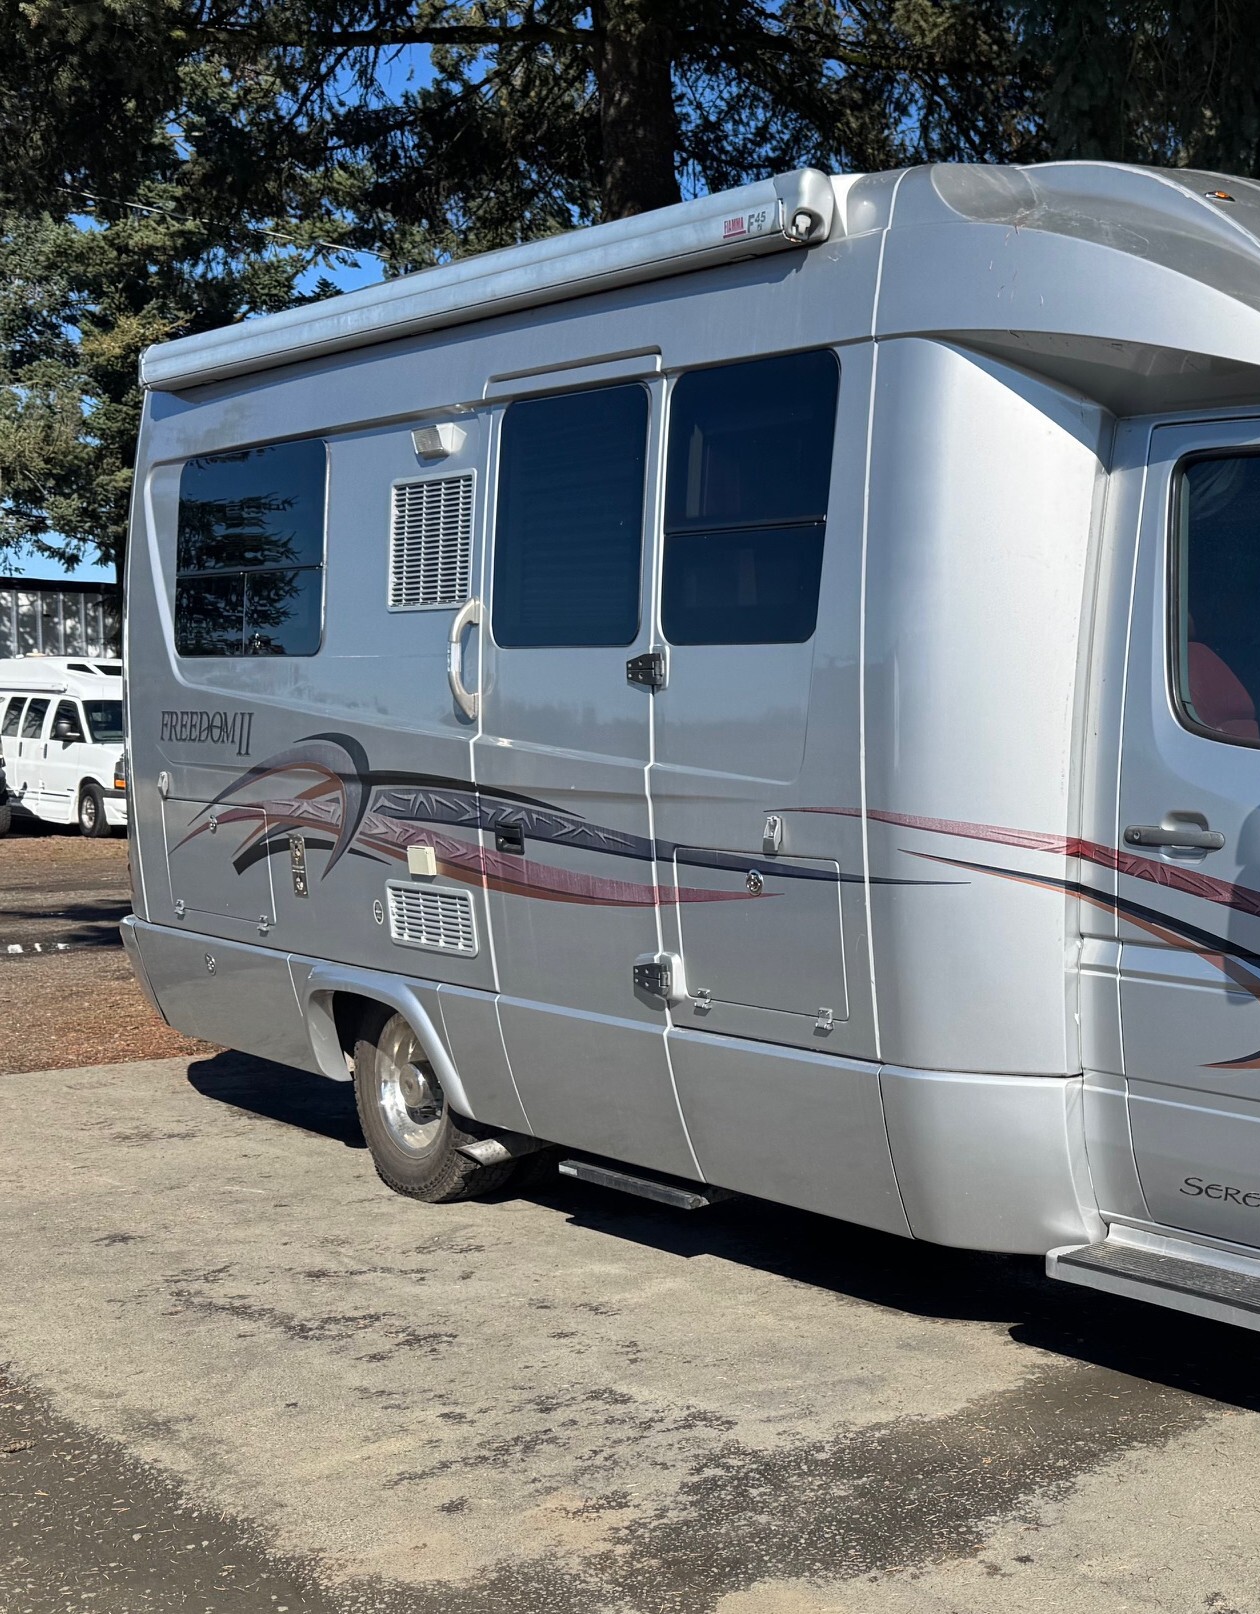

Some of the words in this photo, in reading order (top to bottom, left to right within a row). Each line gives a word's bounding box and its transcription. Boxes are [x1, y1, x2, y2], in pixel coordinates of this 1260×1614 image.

[724, 217, 743, 234] FIAMMA
[748, 211, 766, 233] F45
[160, 710, 238, 744] FREEDOM
[237, 711, 254, 756] II
